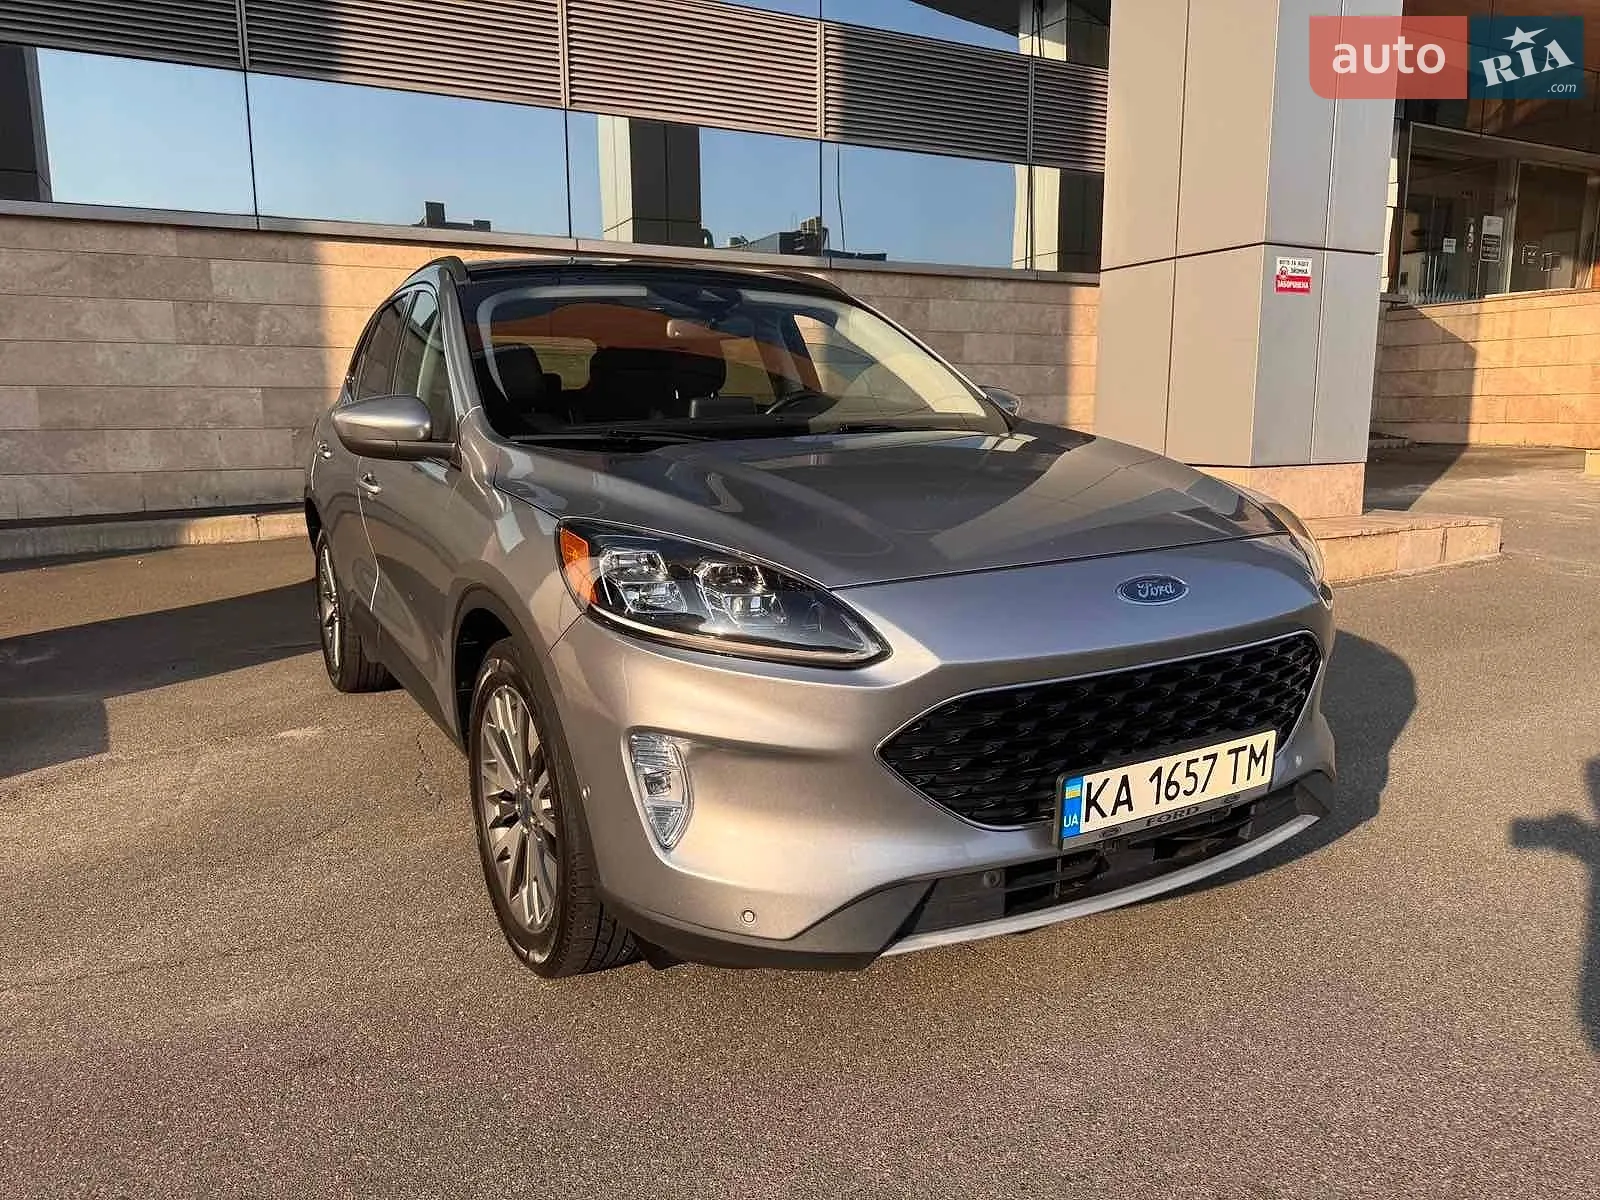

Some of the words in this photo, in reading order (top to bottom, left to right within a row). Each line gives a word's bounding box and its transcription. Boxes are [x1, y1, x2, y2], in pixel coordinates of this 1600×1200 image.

[1136, 582, 1176, 598] Ford
[1085, 774, 1134, 823] KA
[1149, 753, 1218, 805] 1657
[1227, 739, 1269, 785] TM
[1063, 815, 1079, 828] UA
[1145, 806, 1200, 827] FORD
